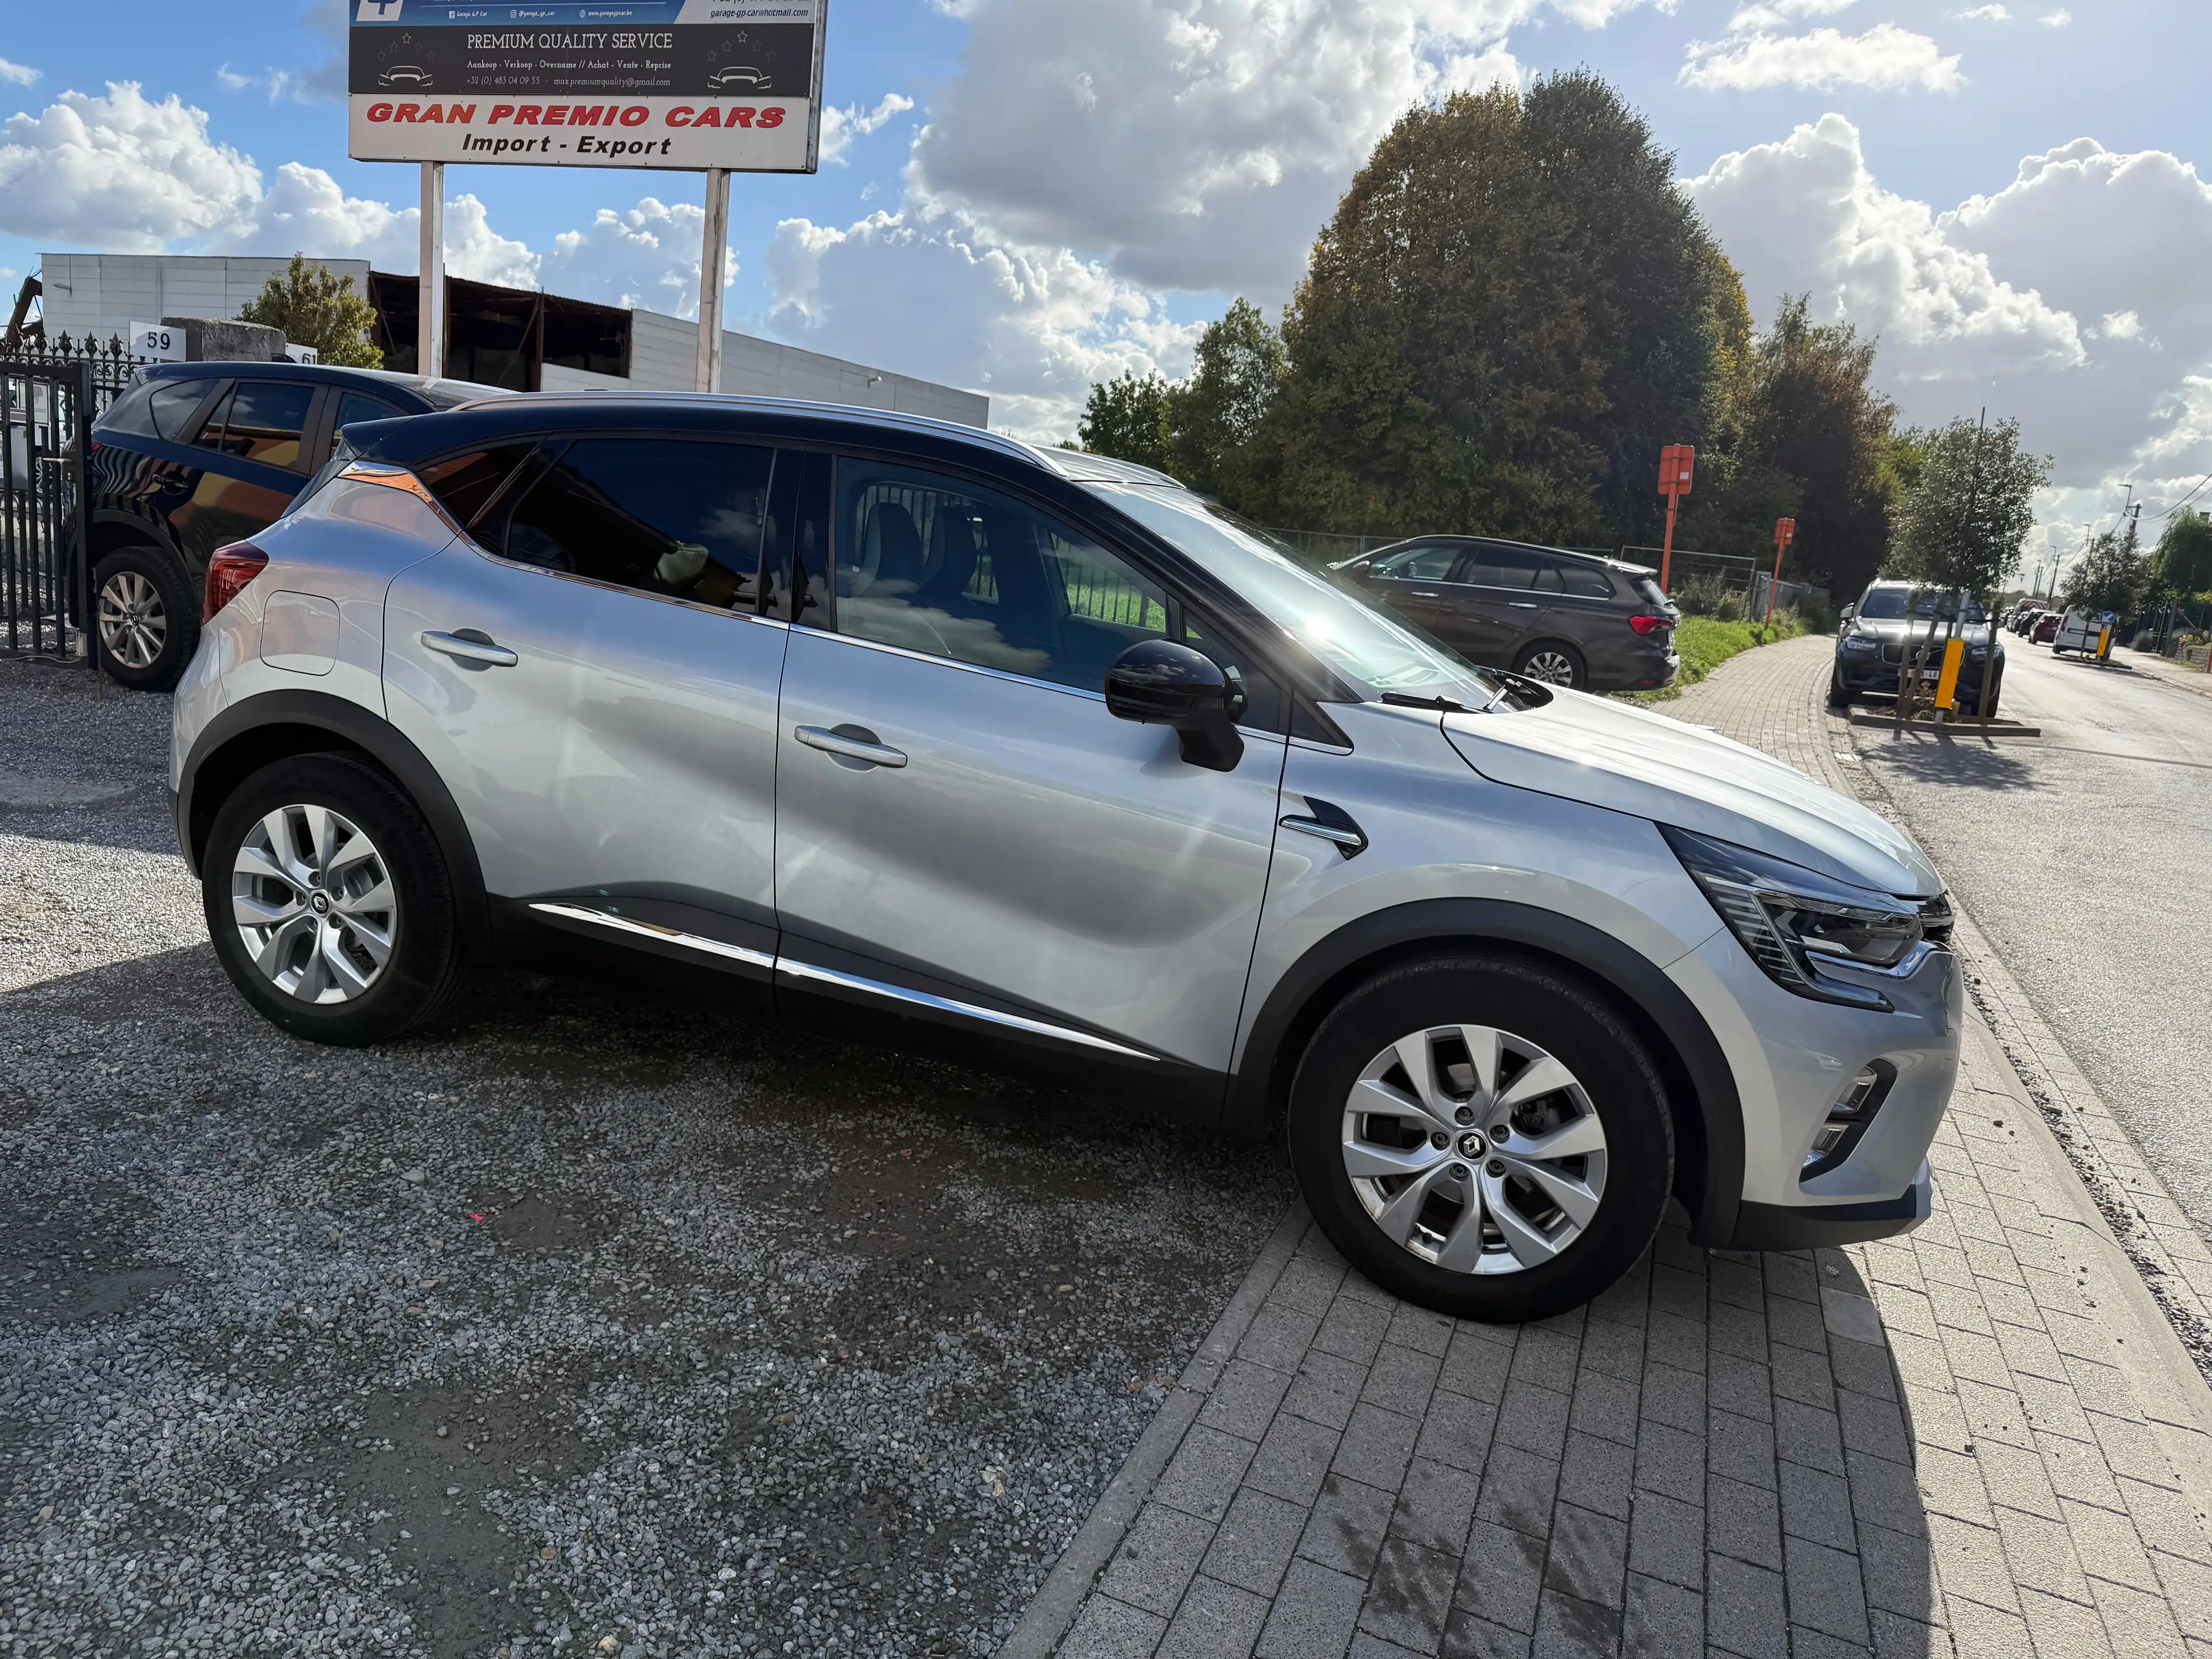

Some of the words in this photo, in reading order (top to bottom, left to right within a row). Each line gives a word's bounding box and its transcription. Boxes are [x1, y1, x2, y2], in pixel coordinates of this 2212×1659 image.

[710, 9, 808, 18] garage-gp-car@hotmail.com
[467, 34, 535, 48] PREMIUM
[539, 33, 608, 48] QUALITY
[611, 33, 672, 48] SERVICE
[467, 59, 497, 70] Aankoop
[504, 60, 533, 70] Verkoop
[539, 60, 577, 69] Overname
[588, 60, 609, 69] Achat
[616, 60, 638, 69] Vente
[646, 60, 671, 71] Reprise
[467, 76, 479, 84] +32
[481, 75, 492, 85] (0)
[494, 76, 506, 84] 483
[508, 76, 518, 84] 04
[520, 76, 529, 84] 09
[531, 76, 540, 84] 55
[366, 103, 478, 124] GRAN
[487, 105, 650, 128] PREMIO
[665, 106, 786, 129] CARS
[462, 133, 551, 154] Import
[577, 135, 672, 156] Export
[147, 331, 171, 350] 59
[302, 353, 316, 365] 61
